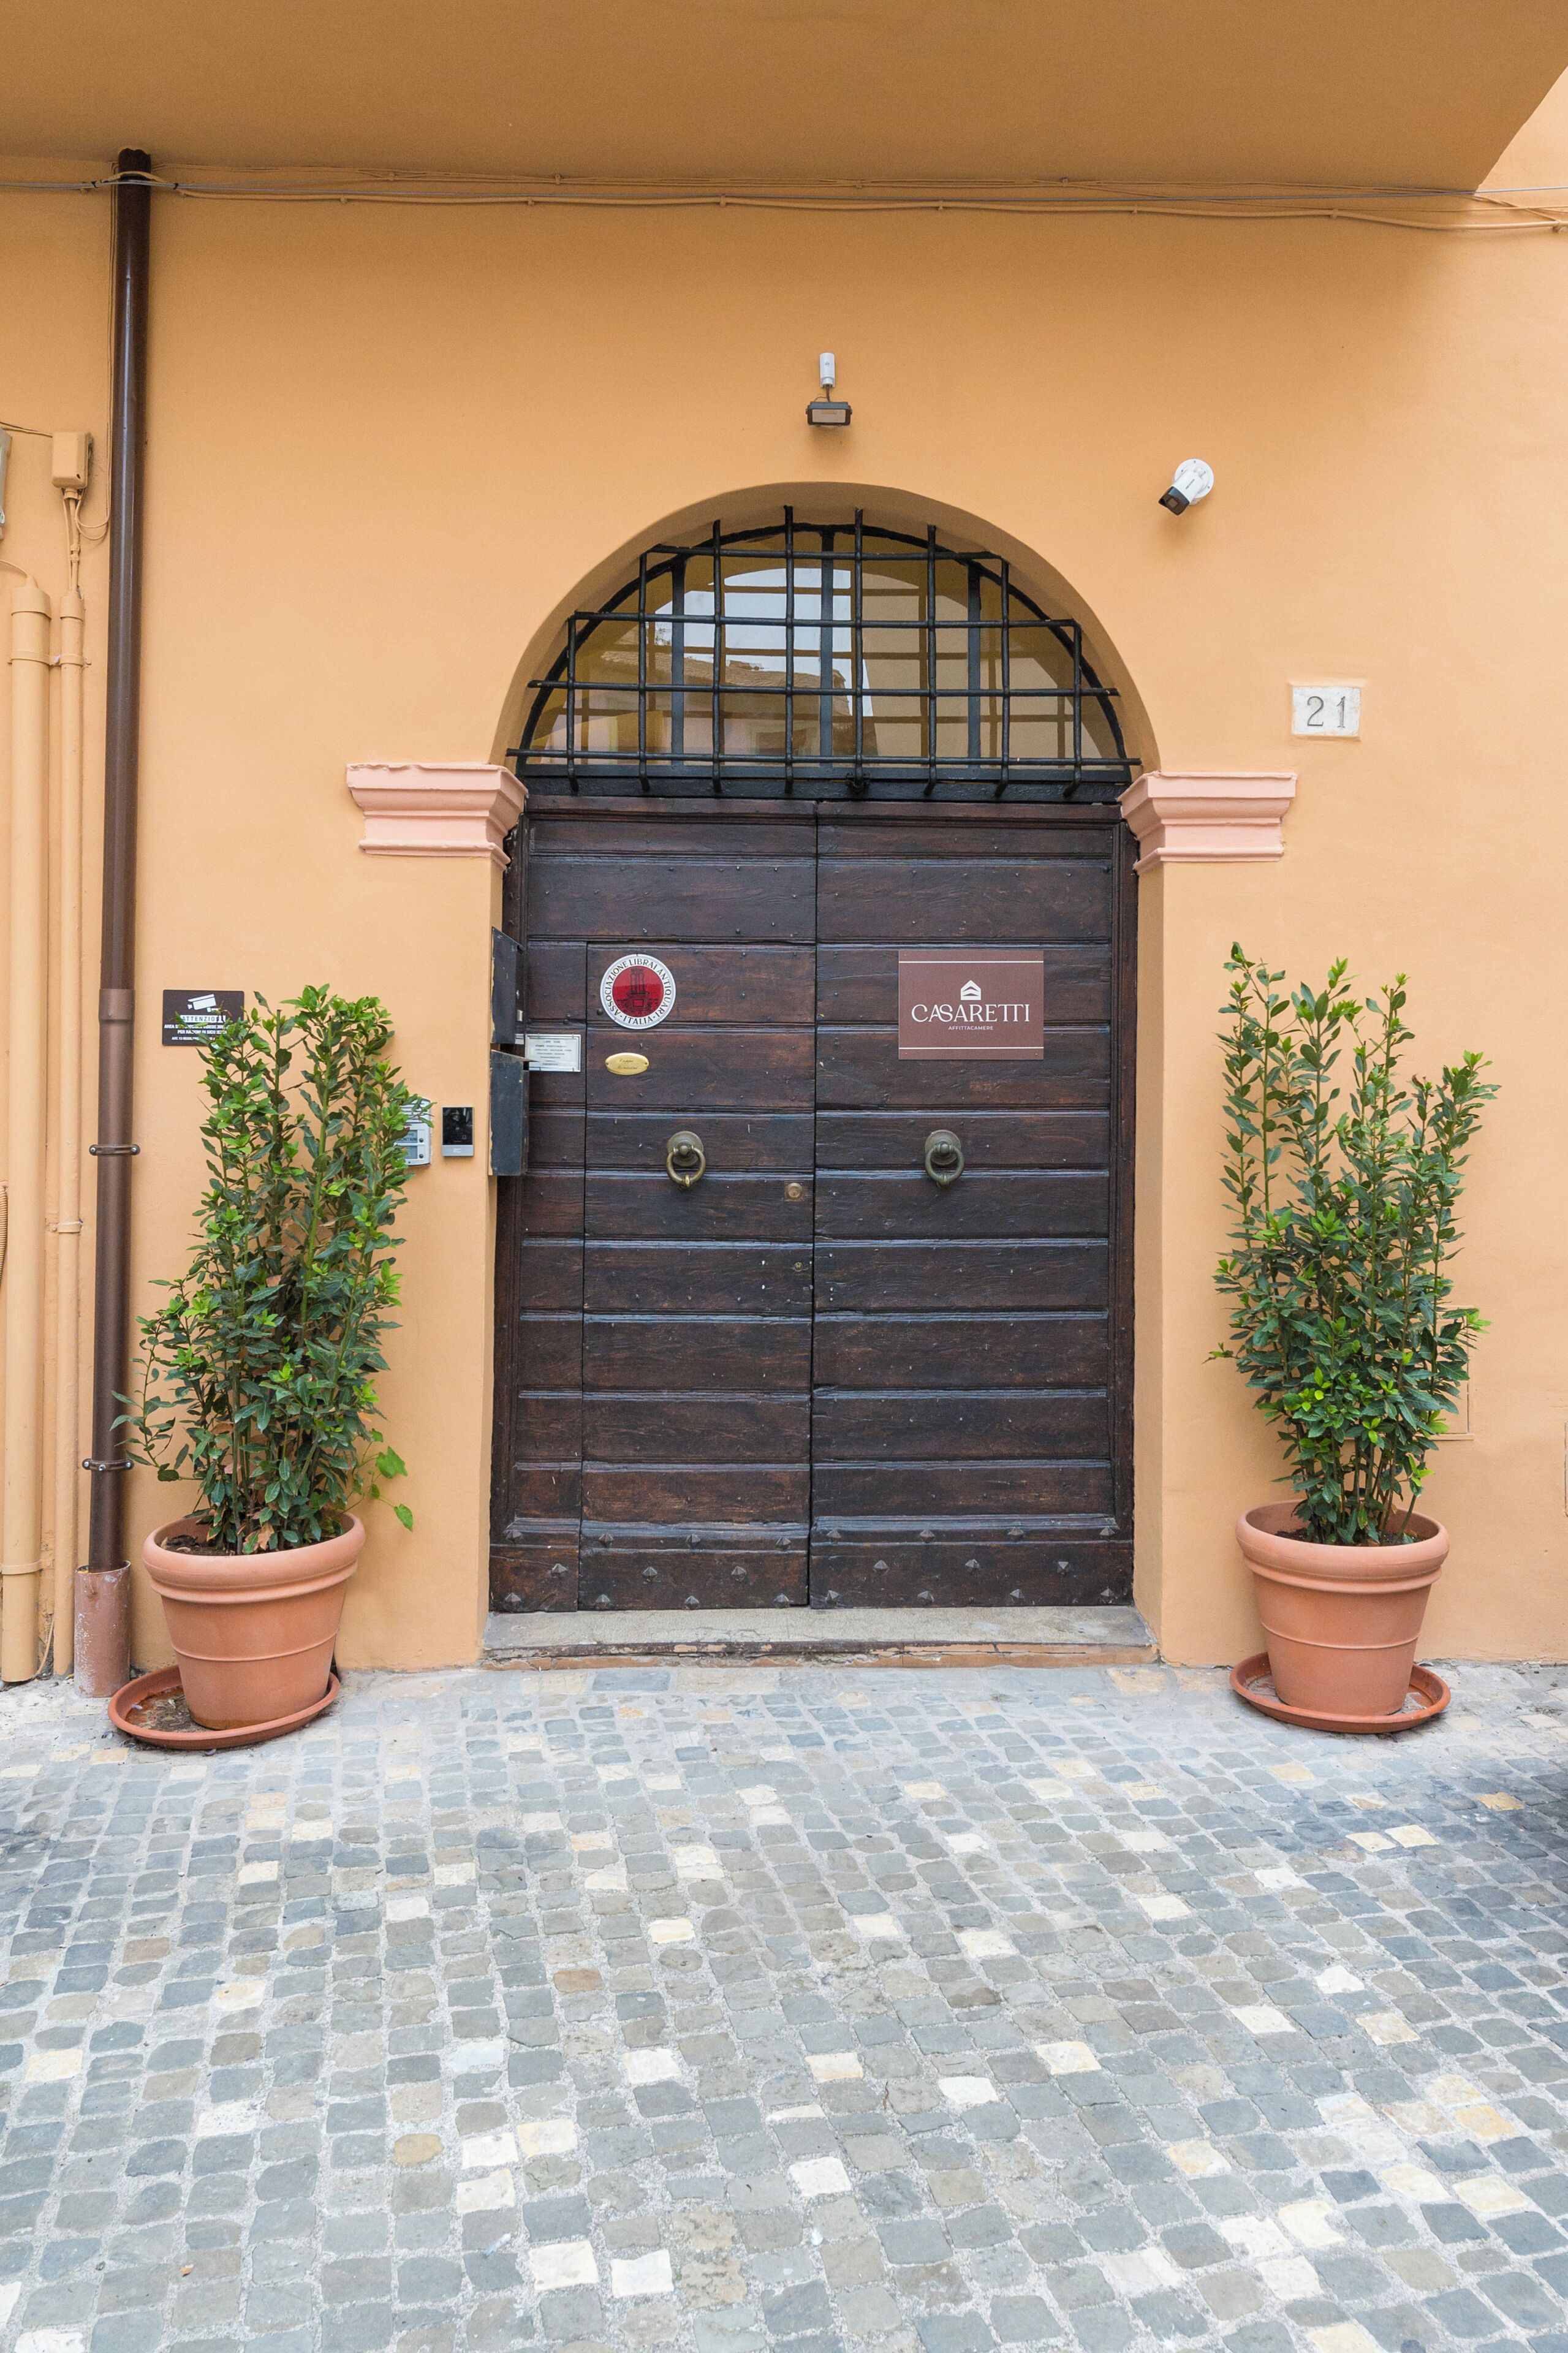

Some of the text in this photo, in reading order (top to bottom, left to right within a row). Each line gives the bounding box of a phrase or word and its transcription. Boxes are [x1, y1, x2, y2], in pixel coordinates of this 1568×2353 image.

[1306, 695, 1346, 729] 21
[604, 958, 672, 1017] ASSOCIAZIONE LIBRAI ANTIQUARI
[623, 1015, 654, 1025] ITALIA
[911, 1004, 1031, 1023] CASARETTI
